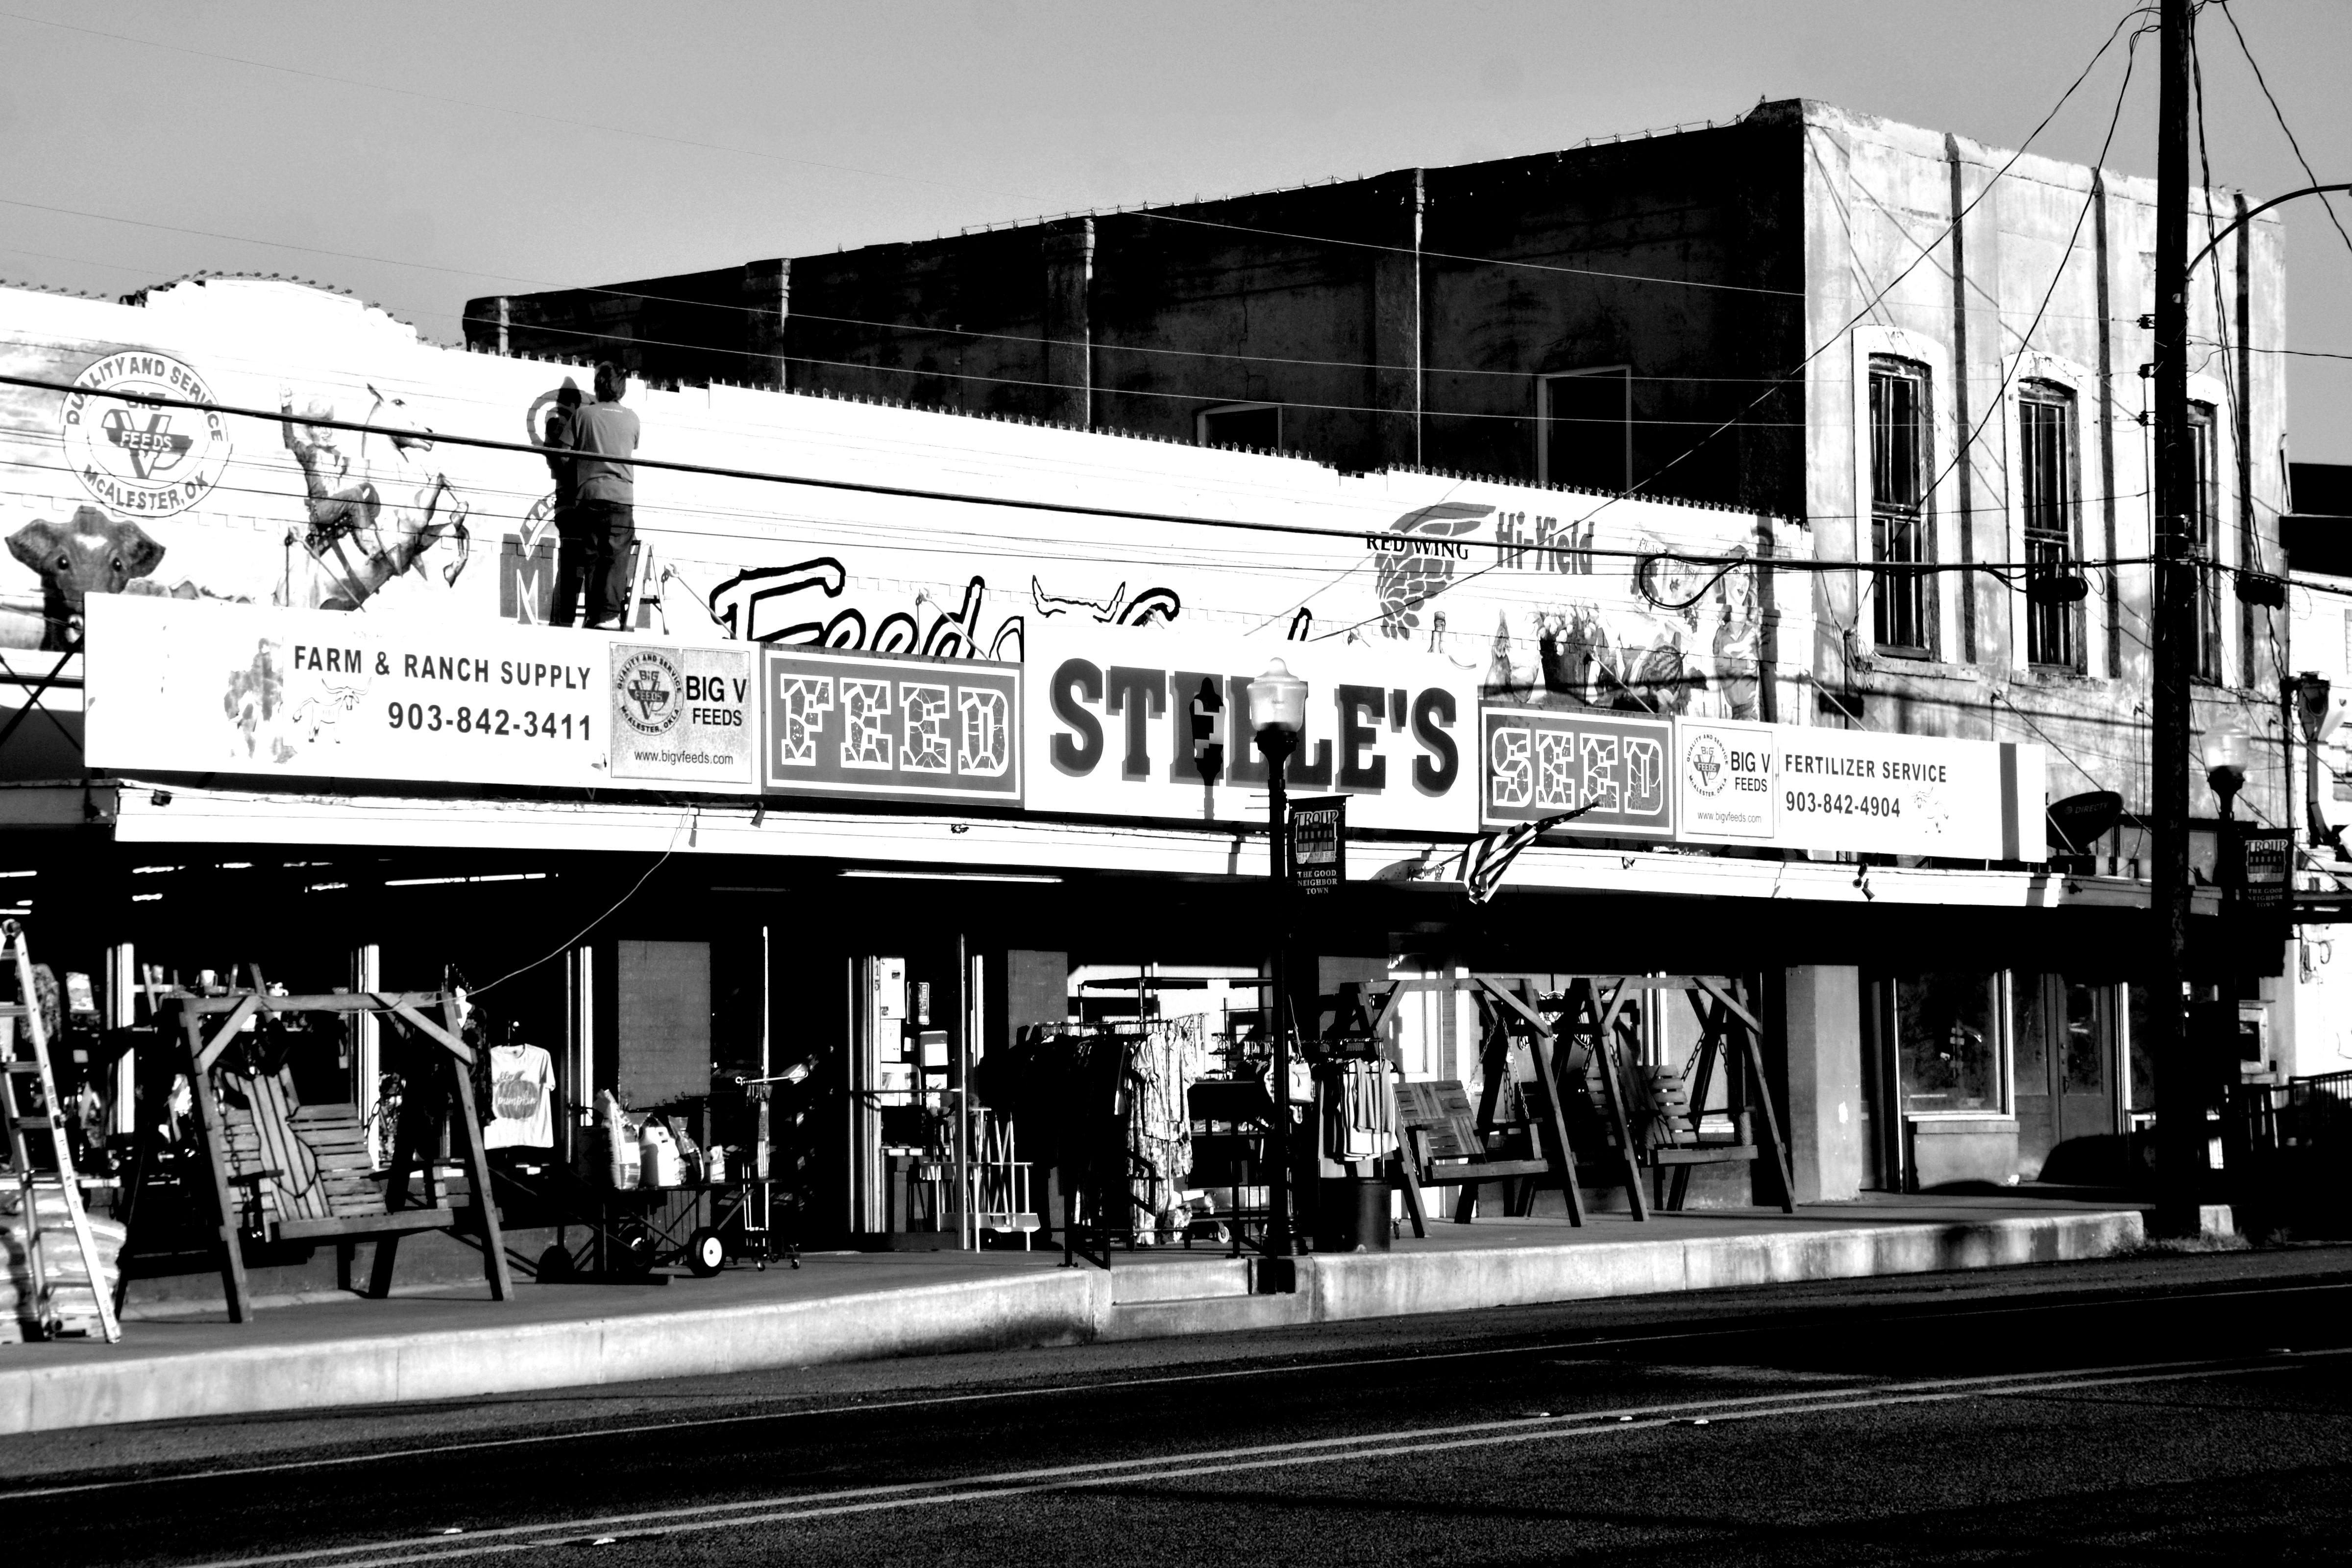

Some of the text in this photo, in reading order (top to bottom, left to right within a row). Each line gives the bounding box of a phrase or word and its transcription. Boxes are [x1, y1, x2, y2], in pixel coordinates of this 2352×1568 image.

[130, 357, 165, 377] AND
[120, 431, 172, 451] FEEDS
[184, 470, 208, 500] OK
[1366, 531, 1469, 560] RED WING
[1495, 511, 1595, 575] Hi-Yield
[294, 646, 591, 689] FARM & RANCH SUPPLY
[617, 655, 639, 689] QUALITY
[660, 658, 682, 693] SERVICE
[635, 690, 662, 701] FEEDS
[686, 676, 747, 703] BIG V
[388, 702, 590, 740] 903-842-3411
[663, 709, 679, 728] OKLA
[692, 708, 742, 726] FEEDS
[780, 673, 1009, 777] FEED
[1050, 658, 1459, 798] STEELE'S
[634, 750, 734, 765] www.bigvfeeds.com
[1687, 735, 1701, 762] QUALITY
[1715, 737, 1728, 765] SERVICE
[1492, 727, 1663, 816] SEED
[1698, 763, 1716, 772] FEEDS
[1731, 751, 1770, 773] BIG V
[1786, 754, 1946, 783] FERTILIZER SERVICE
[1717, 778, 1727, 793] OKLA
[1735, 777, 1767, 792] FEEDS
[1786, 791, 1900, 817] 903-842-4904
[1294, 810, 1339, 826] TROUP
[1698, 811, 1762, 824] www.bigvfeeds.com
[2245, 839, 2288, 852] TROUP
[491, 1071, 514, 1086] ello
